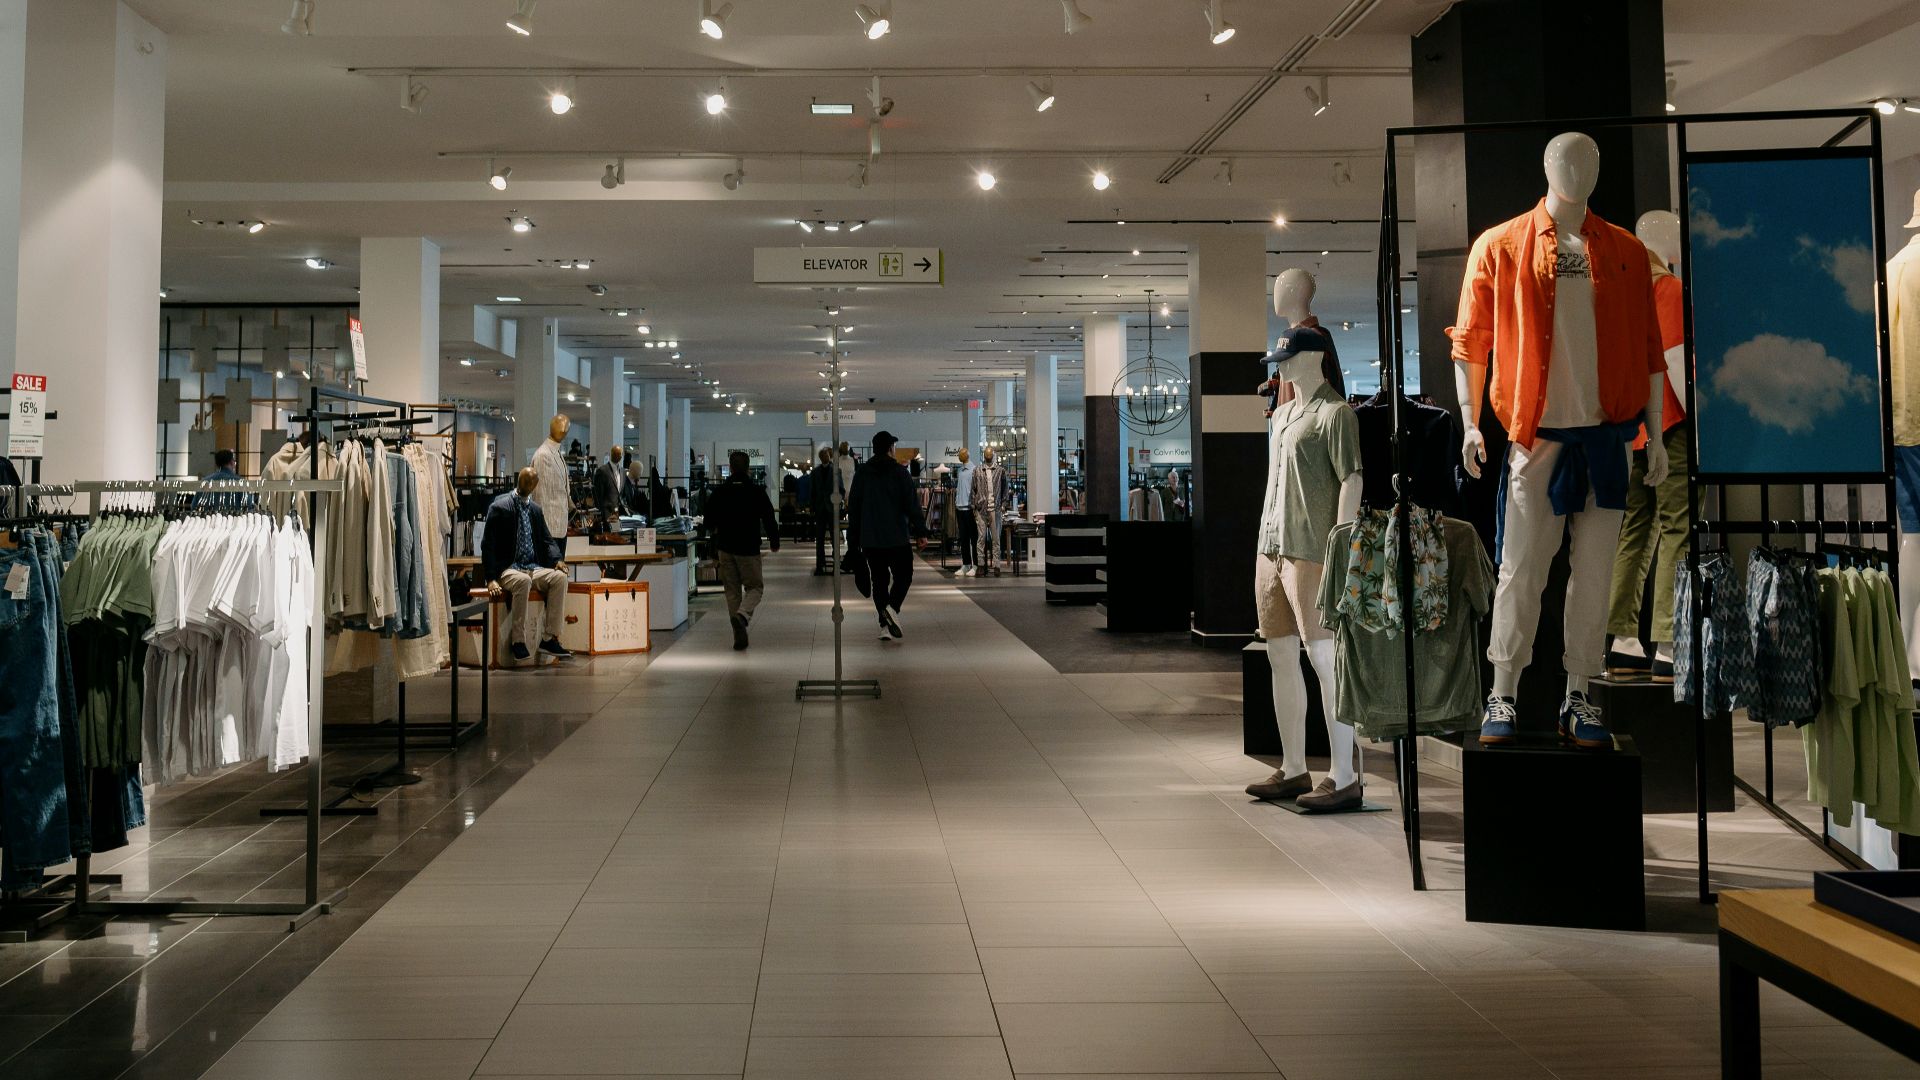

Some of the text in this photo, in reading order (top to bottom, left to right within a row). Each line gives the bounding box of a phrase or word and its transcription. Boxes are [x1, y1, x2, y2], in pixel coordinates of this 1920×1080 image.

[803, 258, 867, 270] ELEVATOR
[16, 375, 42, 391] SALE
[19, 401, 38, 415] 15%
[1153, 448, 1190, 456] Calvin Klein
